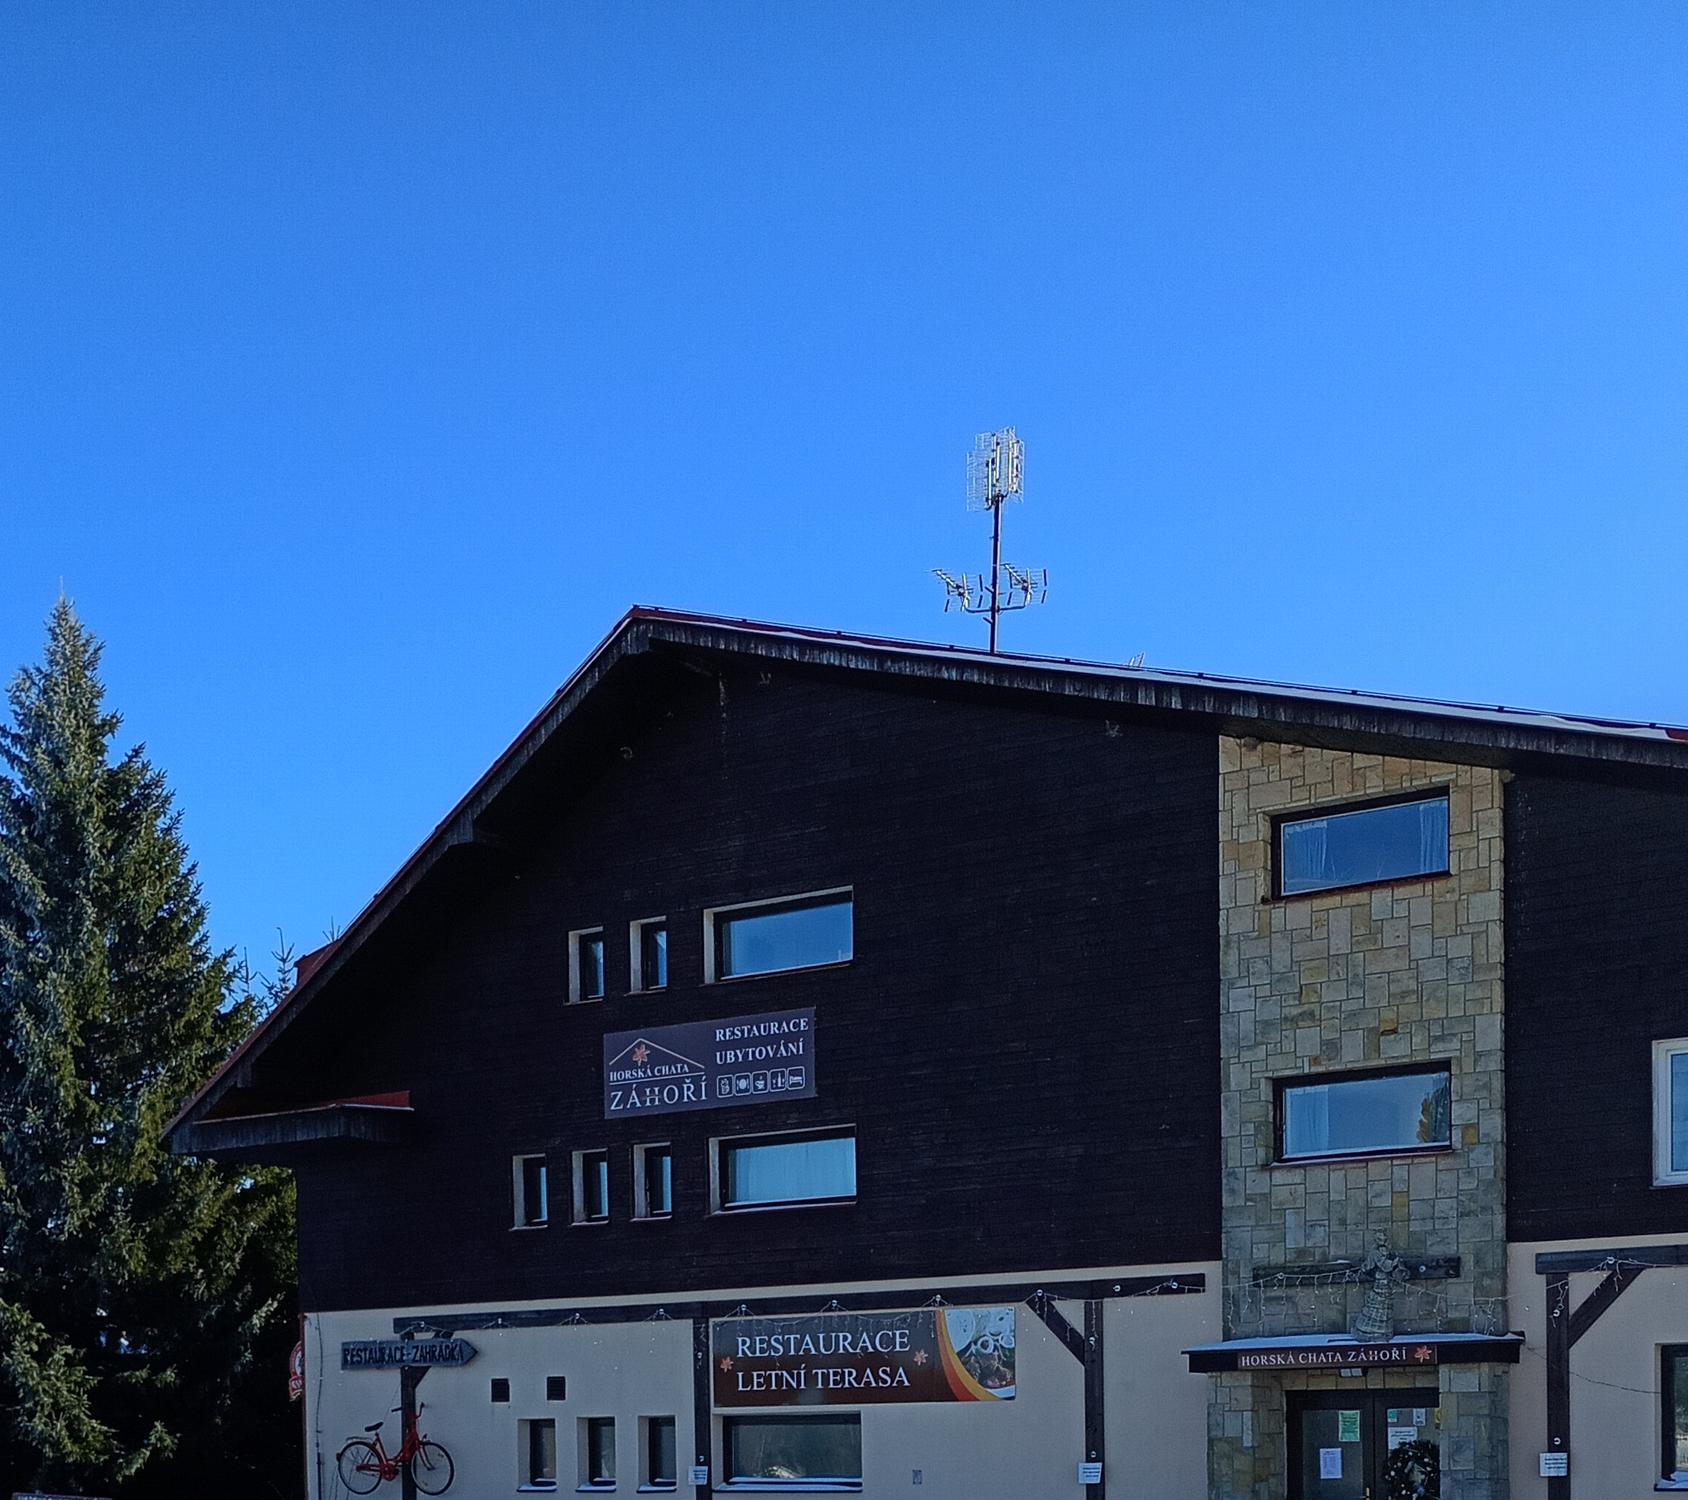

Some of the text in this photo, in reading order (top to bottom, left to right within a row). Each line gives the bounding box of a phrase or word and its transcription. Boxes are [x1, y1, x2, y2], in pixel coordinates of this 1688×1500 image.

[715, 1017, 809, 1042] RESTAURACE
[716, 1038, 805, 1065] UBYTOVÁNÍ
[609, 1063, 690, 1082] HORSKÁ CHATA
[610, 1075, 707, 1111] ZÁHOŘÍ
[343, 1346, 406, 1365] RESTAURACE
[736, 1329, 911, 1358] RESTAURACE
[1241, 1346, 1407, 1367] HORSKÁ CHATA ZÁHOŘÍ
[736, 1363, 911, 1392] LETNÍ TERASA
